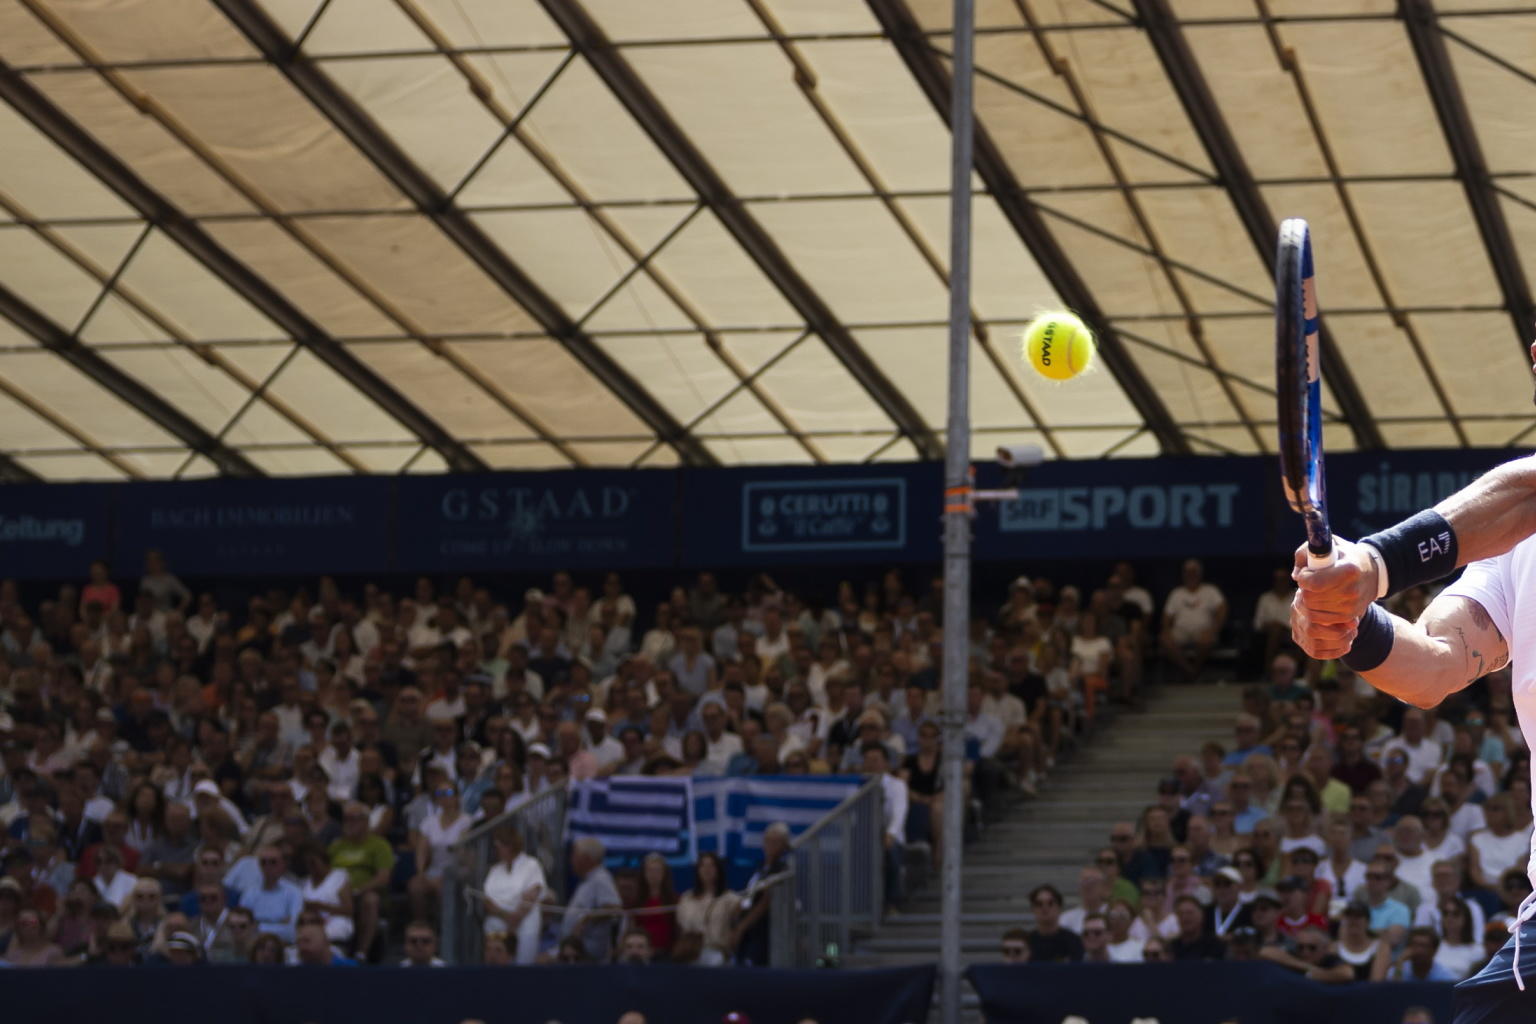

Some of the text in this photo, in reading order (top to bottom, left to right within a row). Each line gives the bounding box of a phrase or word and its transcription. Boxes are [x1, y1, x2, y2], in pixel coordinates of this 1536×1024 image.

[441, 486, 630, 521] GSTAAD
[780, 494, 869, 515] CERUTTI
[1061, 485, 1239, 530] SPORT
[1418, 531, 1451, 562] EA7
